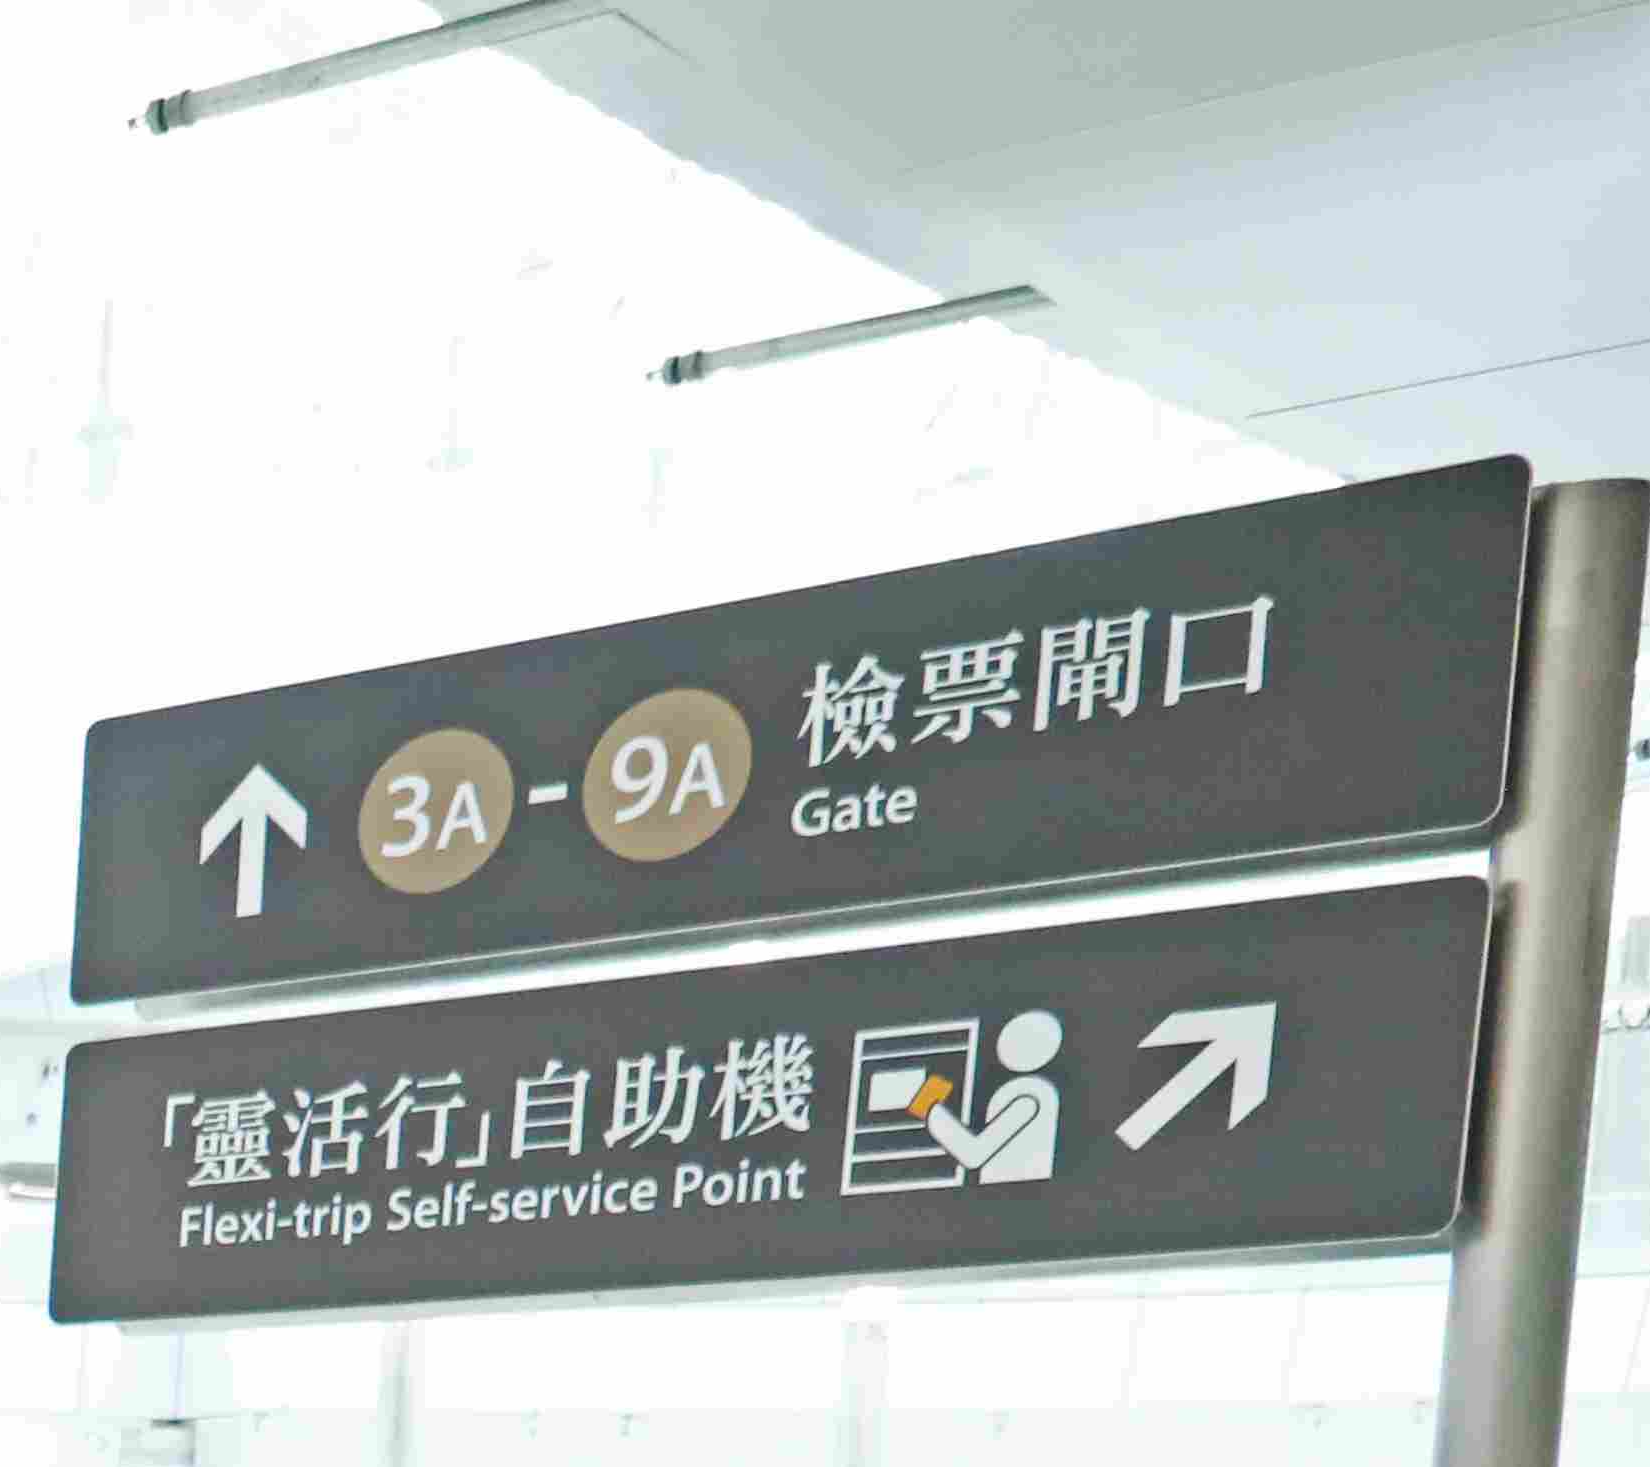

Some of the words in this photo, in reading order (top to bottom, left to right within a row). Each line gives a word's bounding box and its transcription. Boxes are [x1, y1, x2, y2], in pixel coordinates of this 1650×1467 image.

[794, 594, 1277, 772] 檢票閘口
[382, 775, 488, 859] 3A
[611, 735, 727, 824] 9A
[791, 785, 918, 839] Gate
[179, 1192, 373, 1250] Flexi-trip
[385, 1168, 660, 1236] Self-service
[672, 1156, 808, 1207] Point
